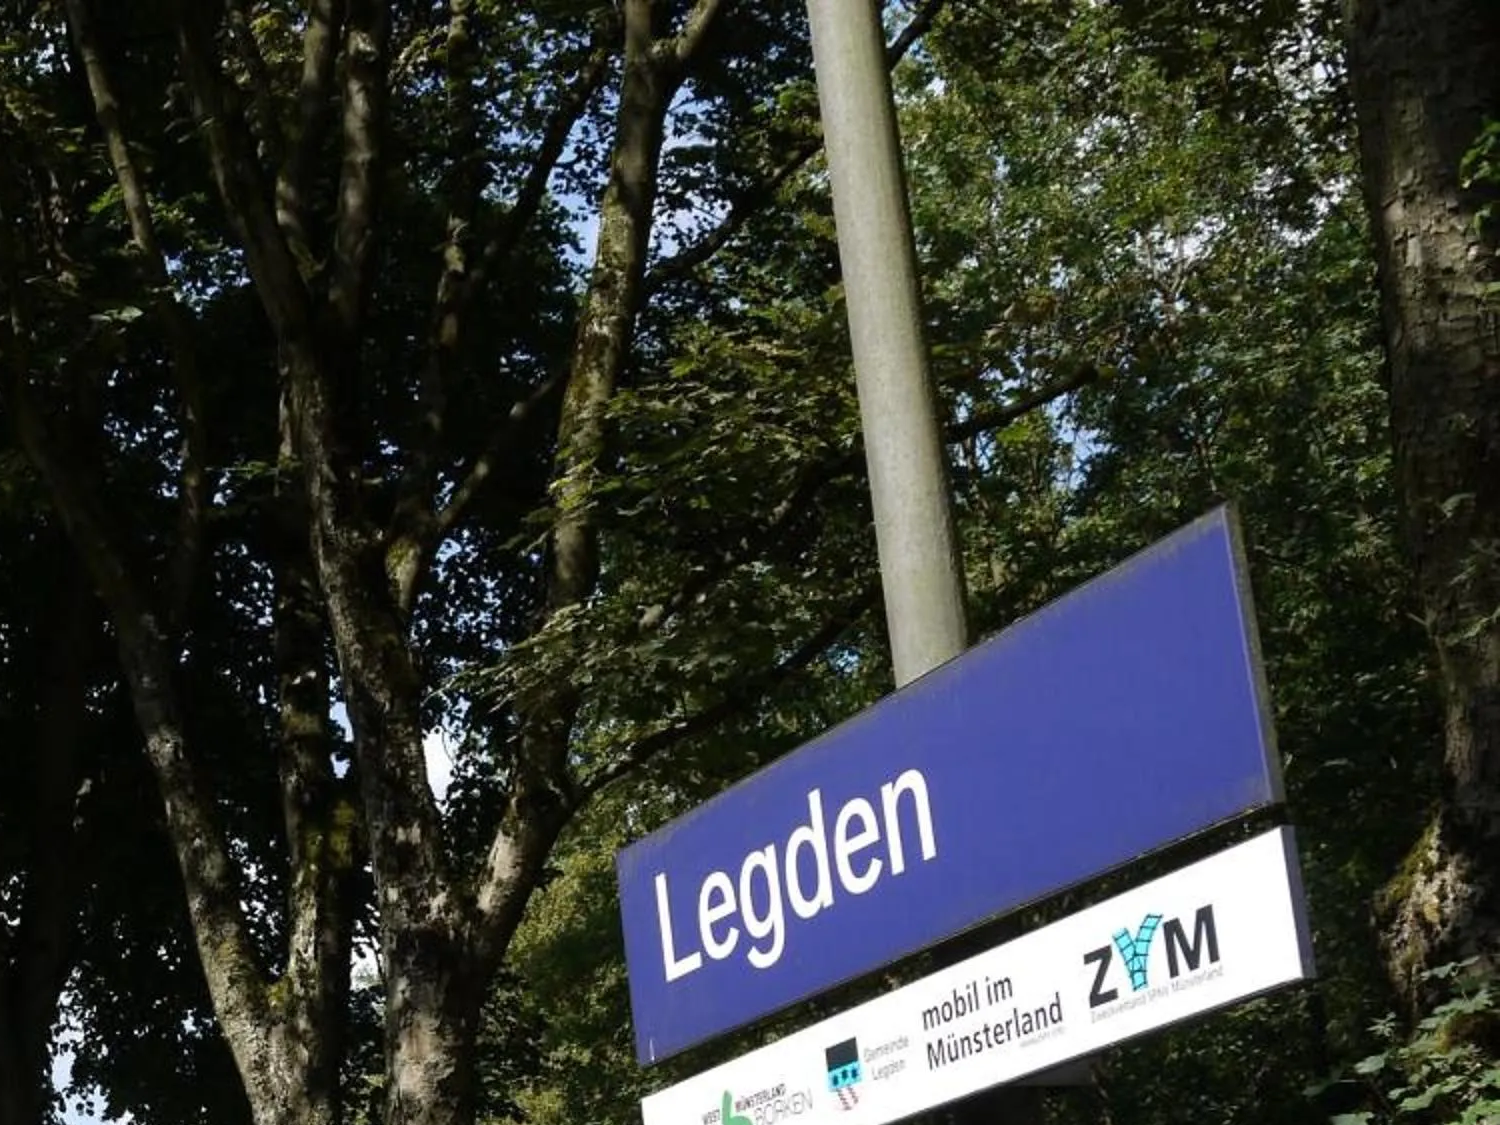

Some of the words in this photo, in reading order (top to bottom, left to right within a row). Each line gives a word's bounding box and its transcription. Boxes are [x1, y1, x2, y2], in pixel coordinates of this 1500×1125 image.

[655, 768, 937, 983] Legden
[922, 980, 980, 1031] mobil
[985, 975, 1013, 1006] im
[926, 991, 1063, 1071] Münsterland
